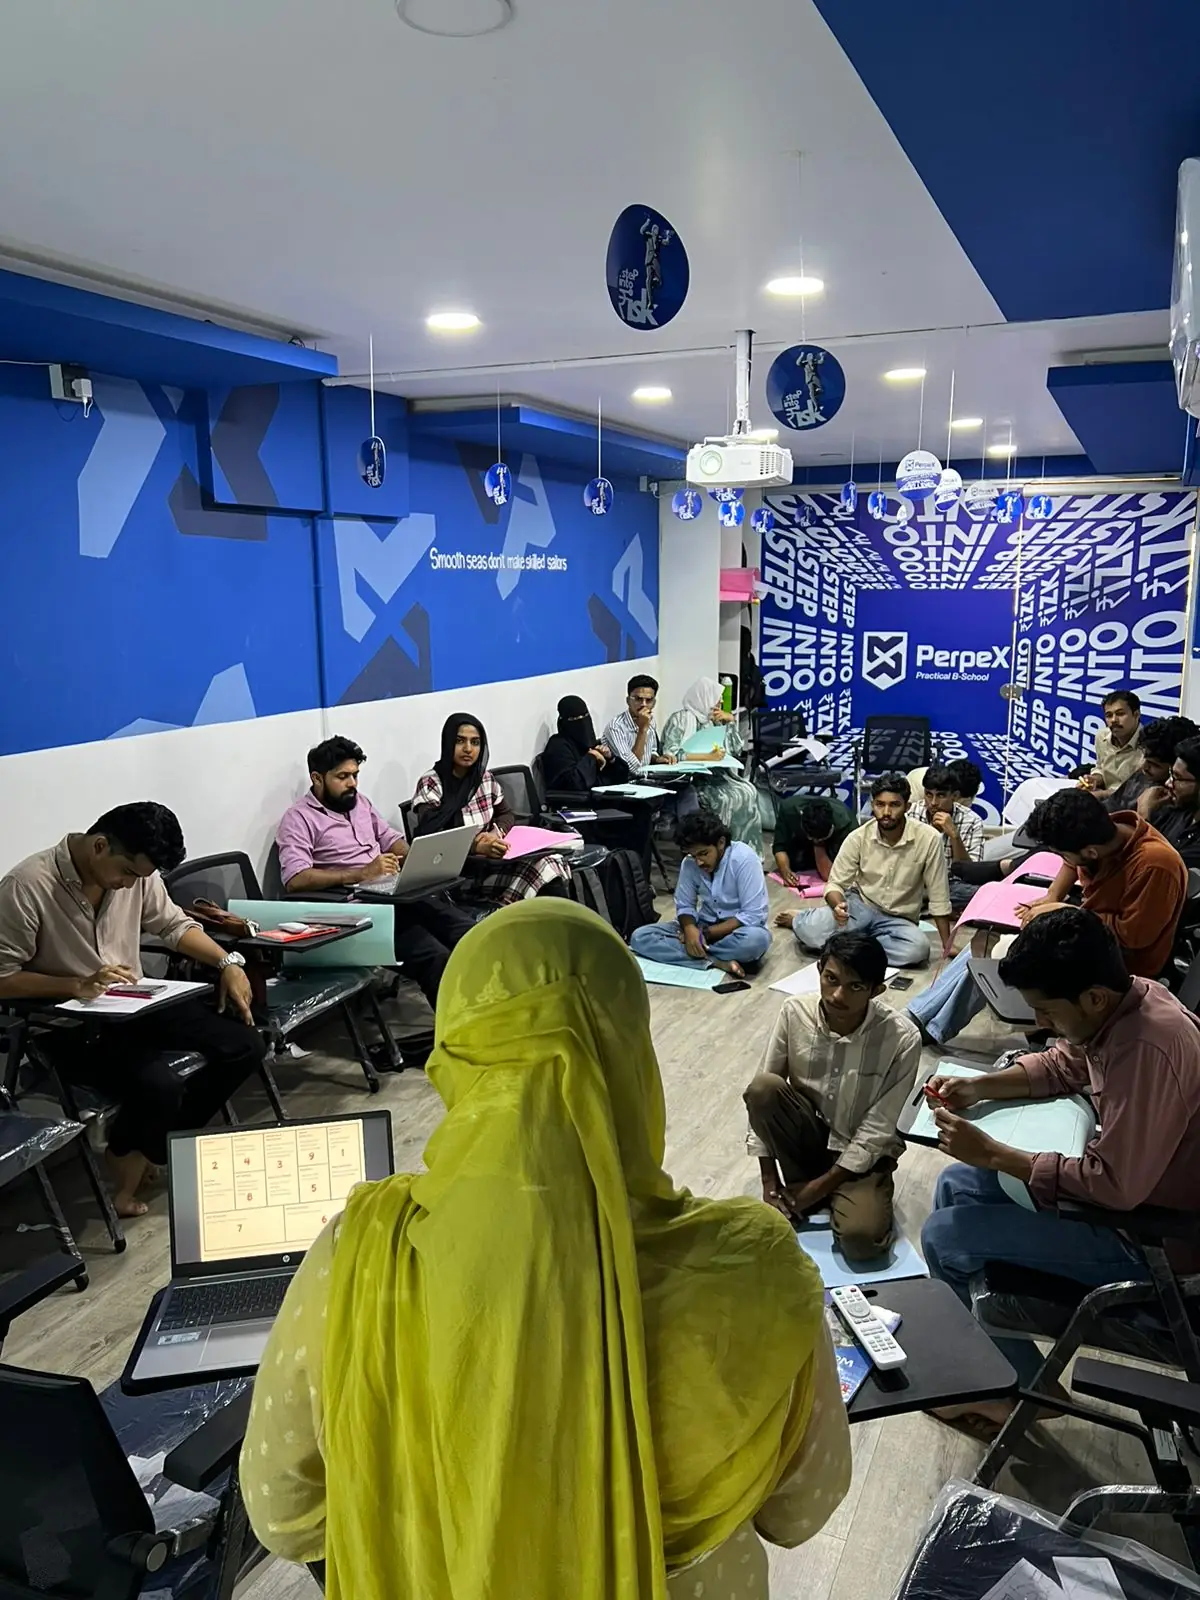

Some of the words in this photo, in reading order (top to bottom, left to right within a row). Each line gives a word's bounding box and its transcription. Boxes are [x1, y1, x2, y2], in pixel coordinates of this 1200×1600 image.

[883, 523, 998, 546] INTO
[1007, 520, 1134, 544] STEP
[430, 547, 466, 570] Smooth
[466, 554, 488, 570] seas
[893, 546, 986, 561] INTO
[994, 545, 1092, 560] STEP
[764, 528, 796, 611] STEP
[899, 561, 978, 572] INTO
[905, 573, 971, 582] INTO
[985, 560, 1065, 572] STEP
[797, 549, 820, 618] STEP
[822, 566, 839, 624] STEP
[842, 580, 856, 629] STEP
[762, 616, 793, 697] INTO
[793, 623, 818, 691] INTO
[819, 629, 838, 687] INTO
[840, 633, 855, 683] INTO
[916, 645, 1011, 673] PerpeX
[1016, 637, 1032, 688] INTO
[1034, 633, 1056, 694] INTO
[1057, 628, 1088, 701] INTO
[1129, 610, 1187, 719] INTO
[916, 672, 951, 680] Practical
[951, 672, 990, 681] B-School
[1030, 699, 1051, 757] STEP
[1052, 706, 1080, 773] STEP
[211, 1161, 219, 1170] 2
[243, 1157, 251, 1166] 4
[276, 1160, 283, 1169] 3
[308, 1152, 315, 1161] 9
[311, 1184, 317, 1192] 5
[237, 1224, 243, 1233] 7
[321, 1215, 328, 1224] 6
